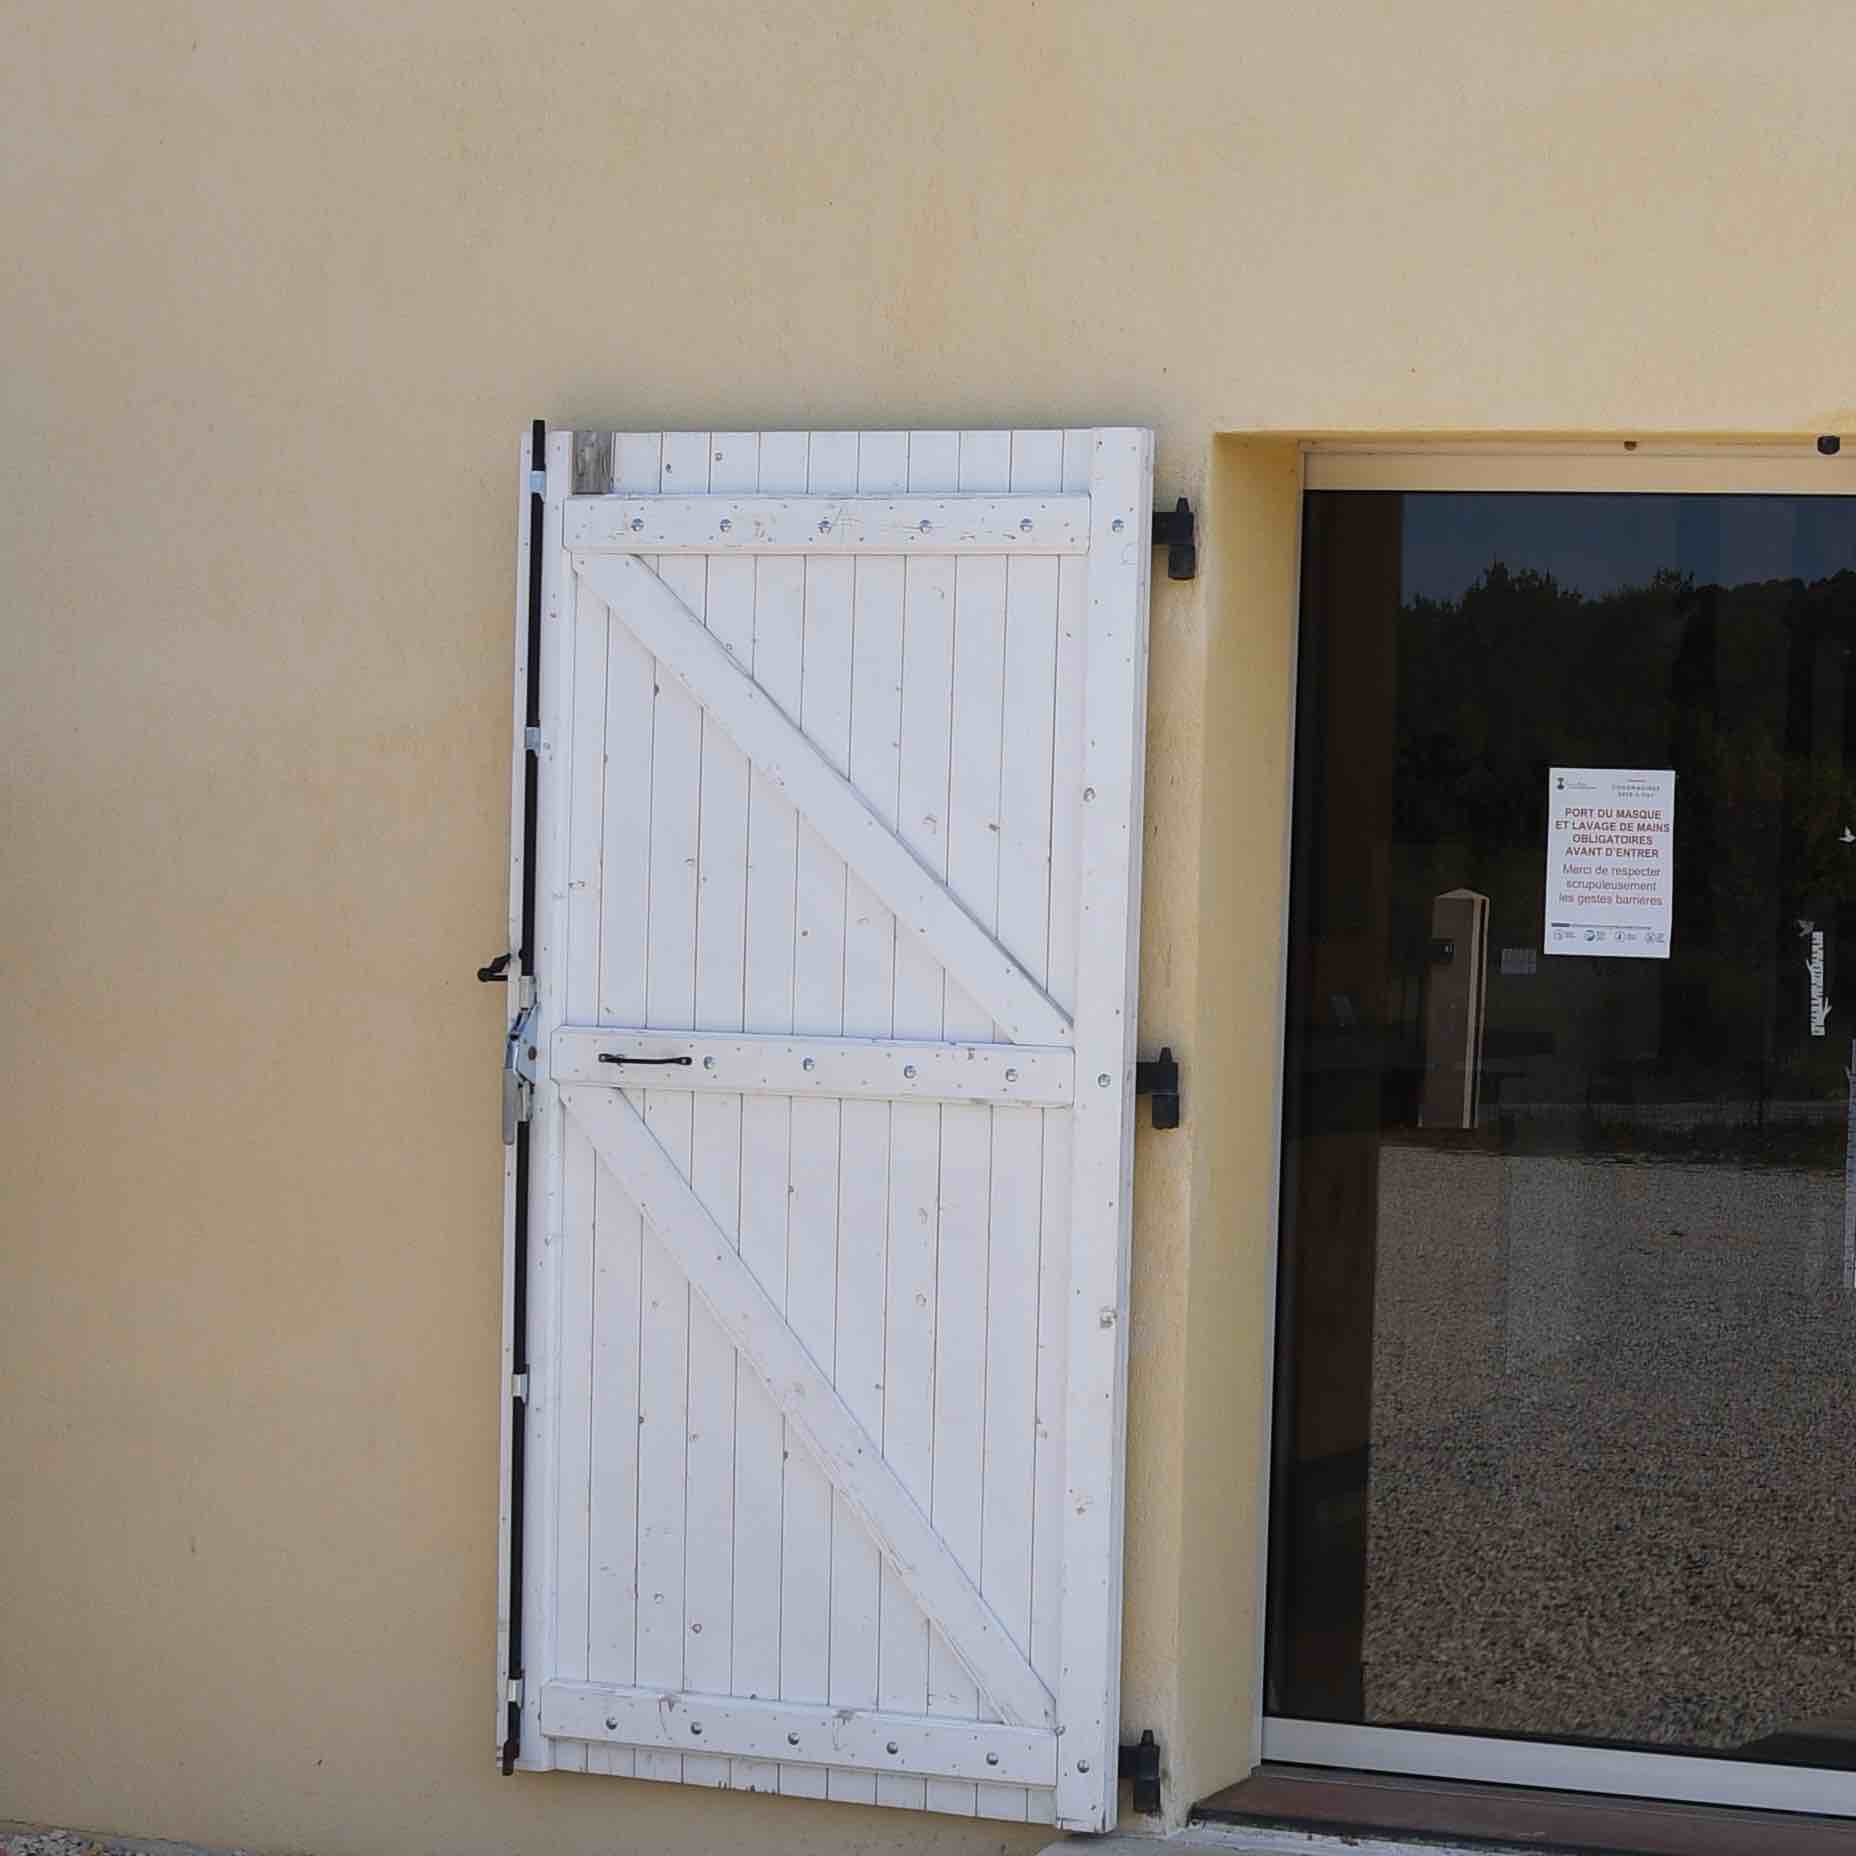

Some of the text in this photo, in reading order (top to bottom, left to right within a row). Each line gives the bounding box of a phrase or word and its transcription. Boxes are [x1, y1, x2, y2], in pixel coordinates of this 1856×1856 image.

[1565, 807, 1662, 820] PORT DU MASQUE
[1555, 820, 1670, 833] ET LAVAGE DE MAINS
[1572, 834, 1653, 845] OBLIGATOIRES
[1565, 846, 1659, 858] AVANT D'ENTRER
[1562, 864, 1661, 878] Merci de respecter
[1566, 879, 1657, 892] scrupuleusement
[1559, 892, 1574, 902] les
[1577, 894, 1613, 906] gestes
